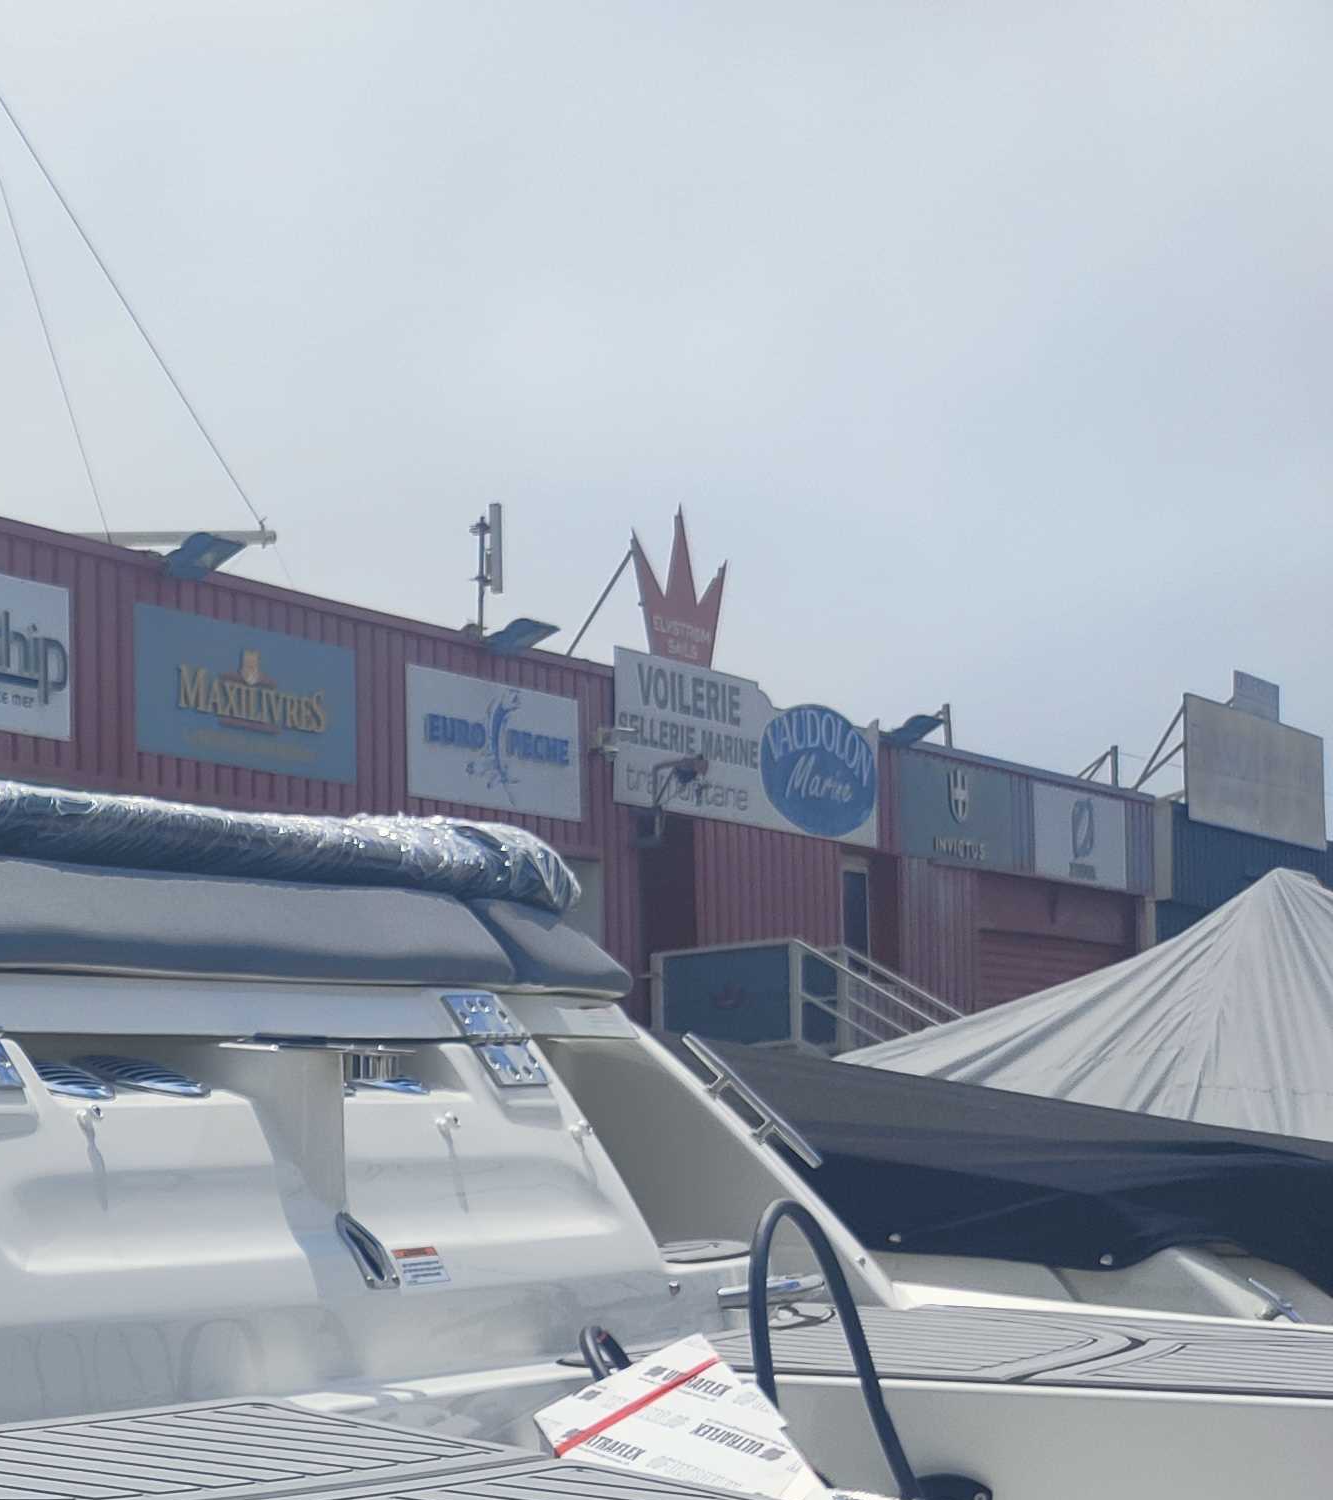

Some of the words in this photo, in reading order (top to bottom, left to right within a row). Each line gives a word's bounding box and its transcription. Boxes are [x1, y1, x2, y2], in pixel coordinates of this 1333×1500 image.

[637, 663, 741, 728] VOILERIE
[425, 713, 486, 749] EURO
[617, 711, 696, 754] SELLERIE
[700, 730, 759, 769] MARINE
[766, 709, 873, 788] VAUDOLON
